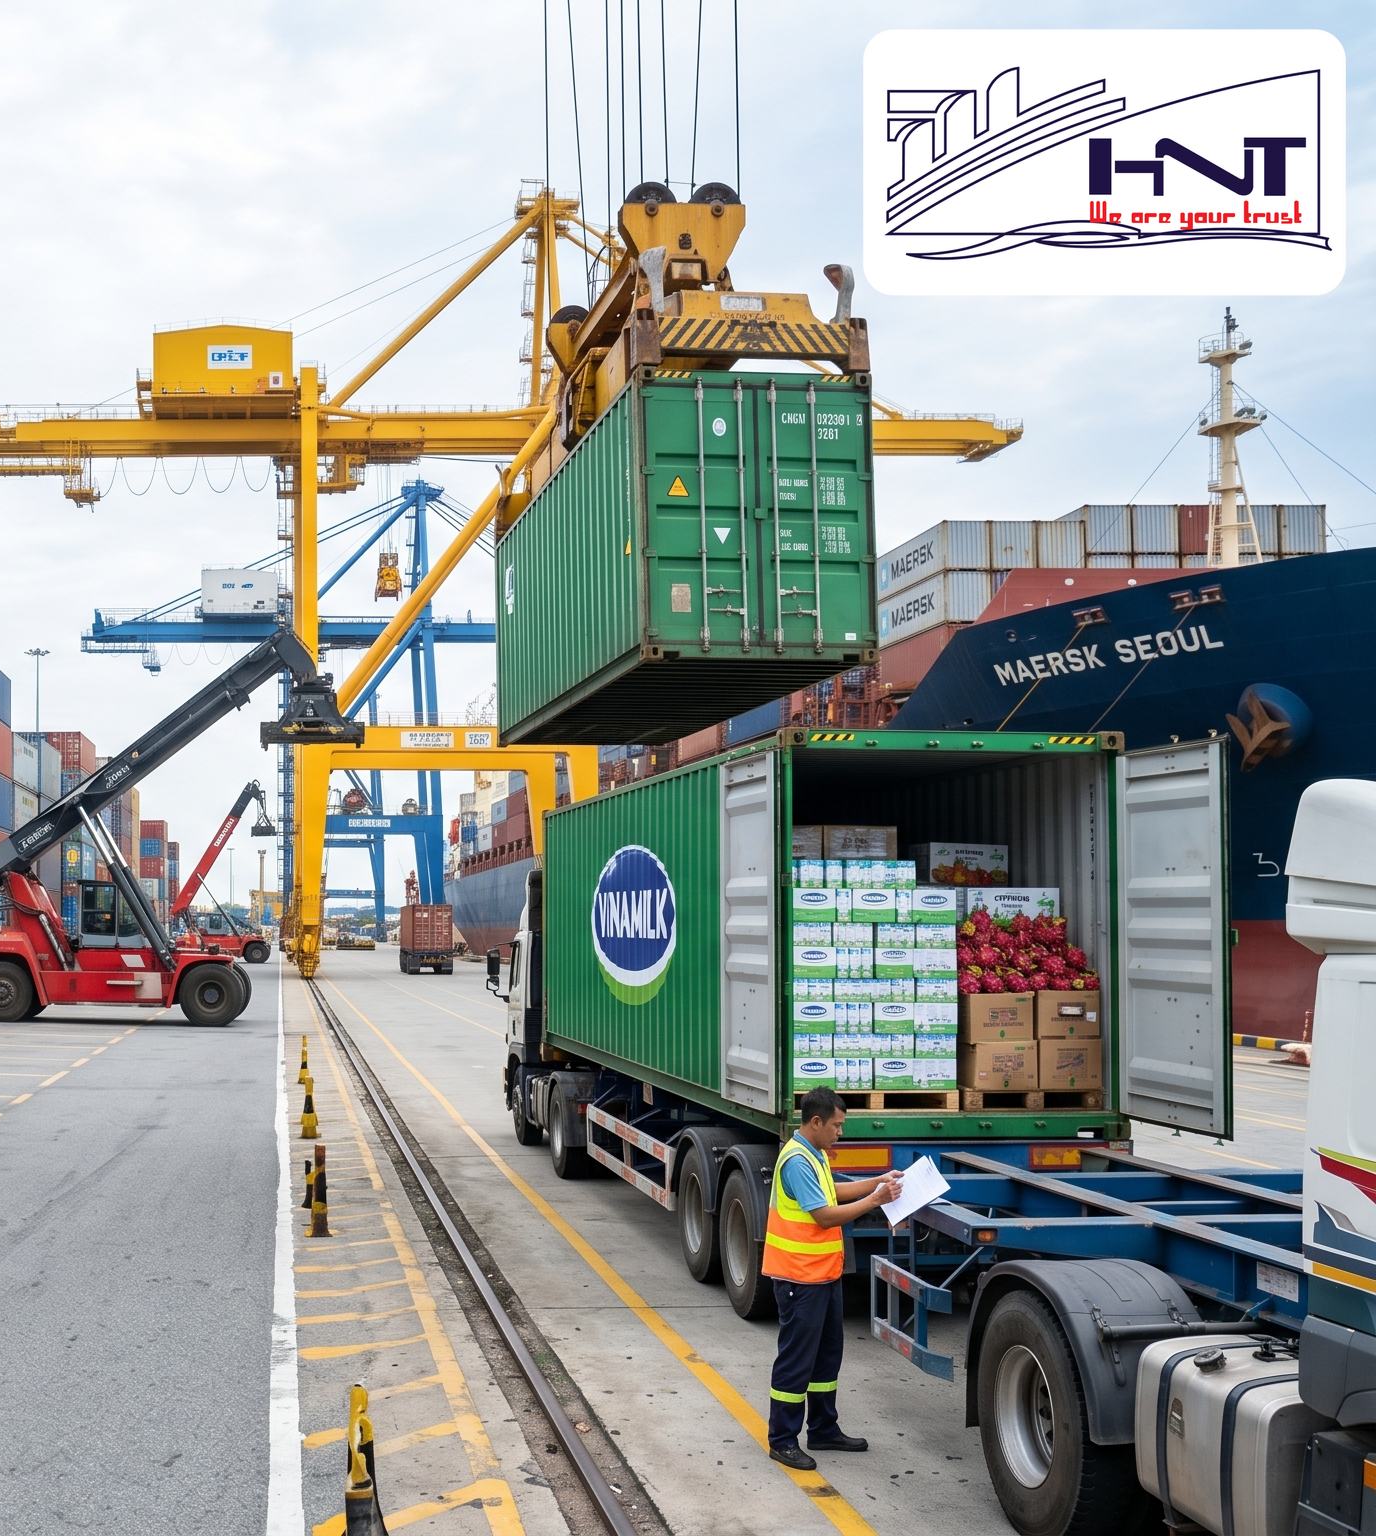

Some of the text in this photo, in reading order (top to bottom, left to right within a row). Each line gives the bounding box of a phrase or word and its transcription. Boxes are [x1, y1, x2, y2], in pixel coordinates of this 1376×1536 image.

[891, 540, 934, 580] MAERSK
[993, 625, 1224, 686] MAERSK SEOUL
[598, 888, 668, 939] VINAMILK
